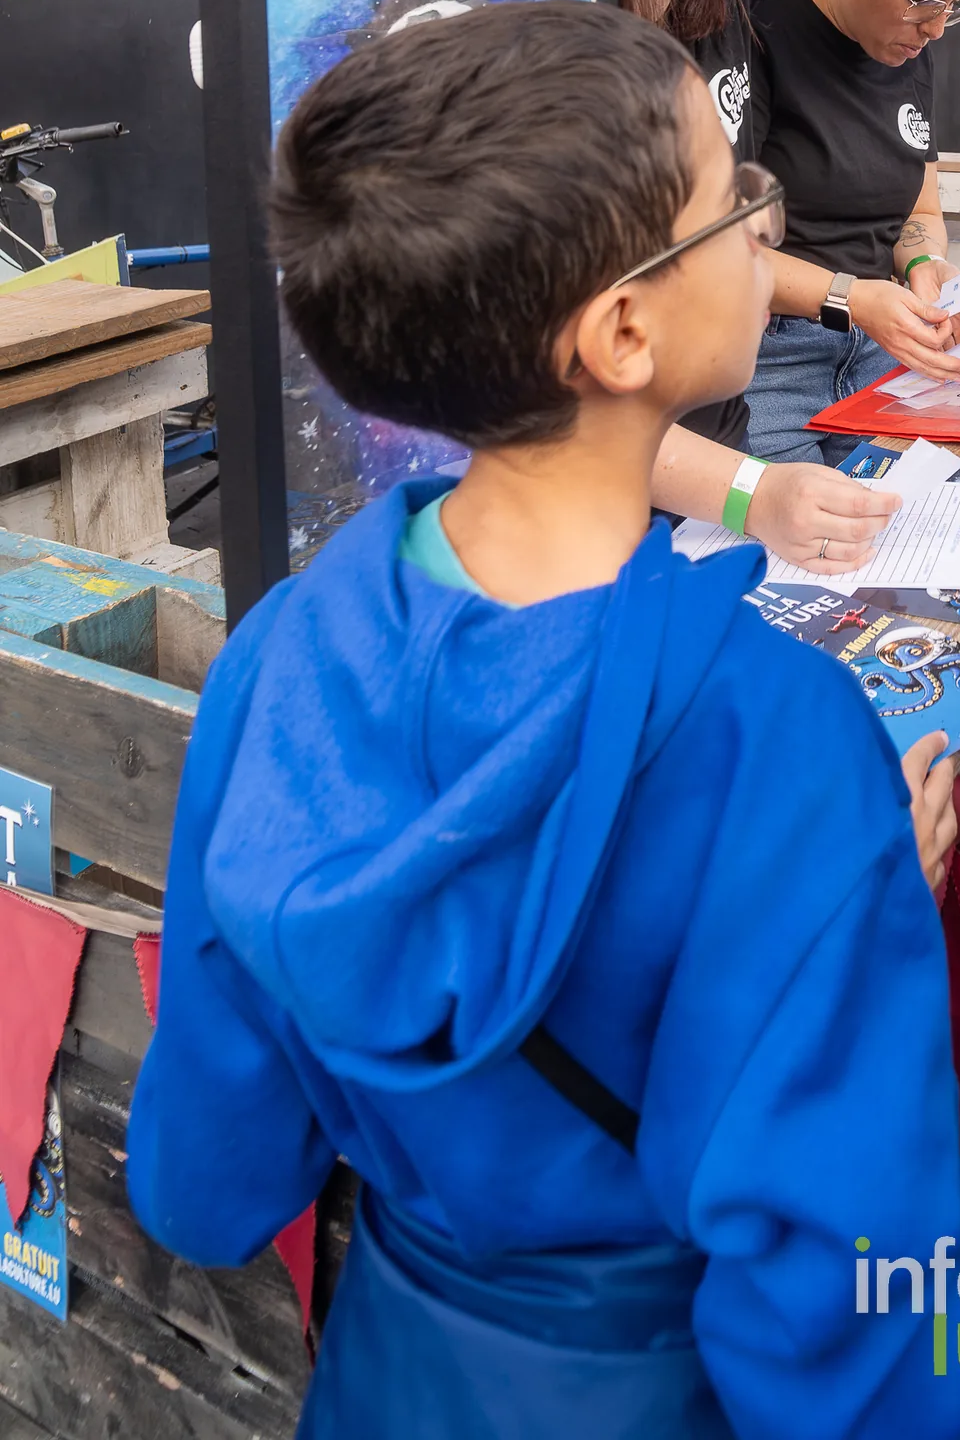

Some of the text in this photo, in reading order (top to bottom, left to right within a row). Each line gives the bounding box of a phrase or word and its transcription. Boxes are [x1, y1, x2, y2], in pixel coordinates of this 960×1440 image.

[767, 596, 802, 614] LA
[771, 594, 844, 633] TURE
[848, 614, 896, 656] NOUVEAUX
[3, 1231, 60, 1283] GRATUIT
